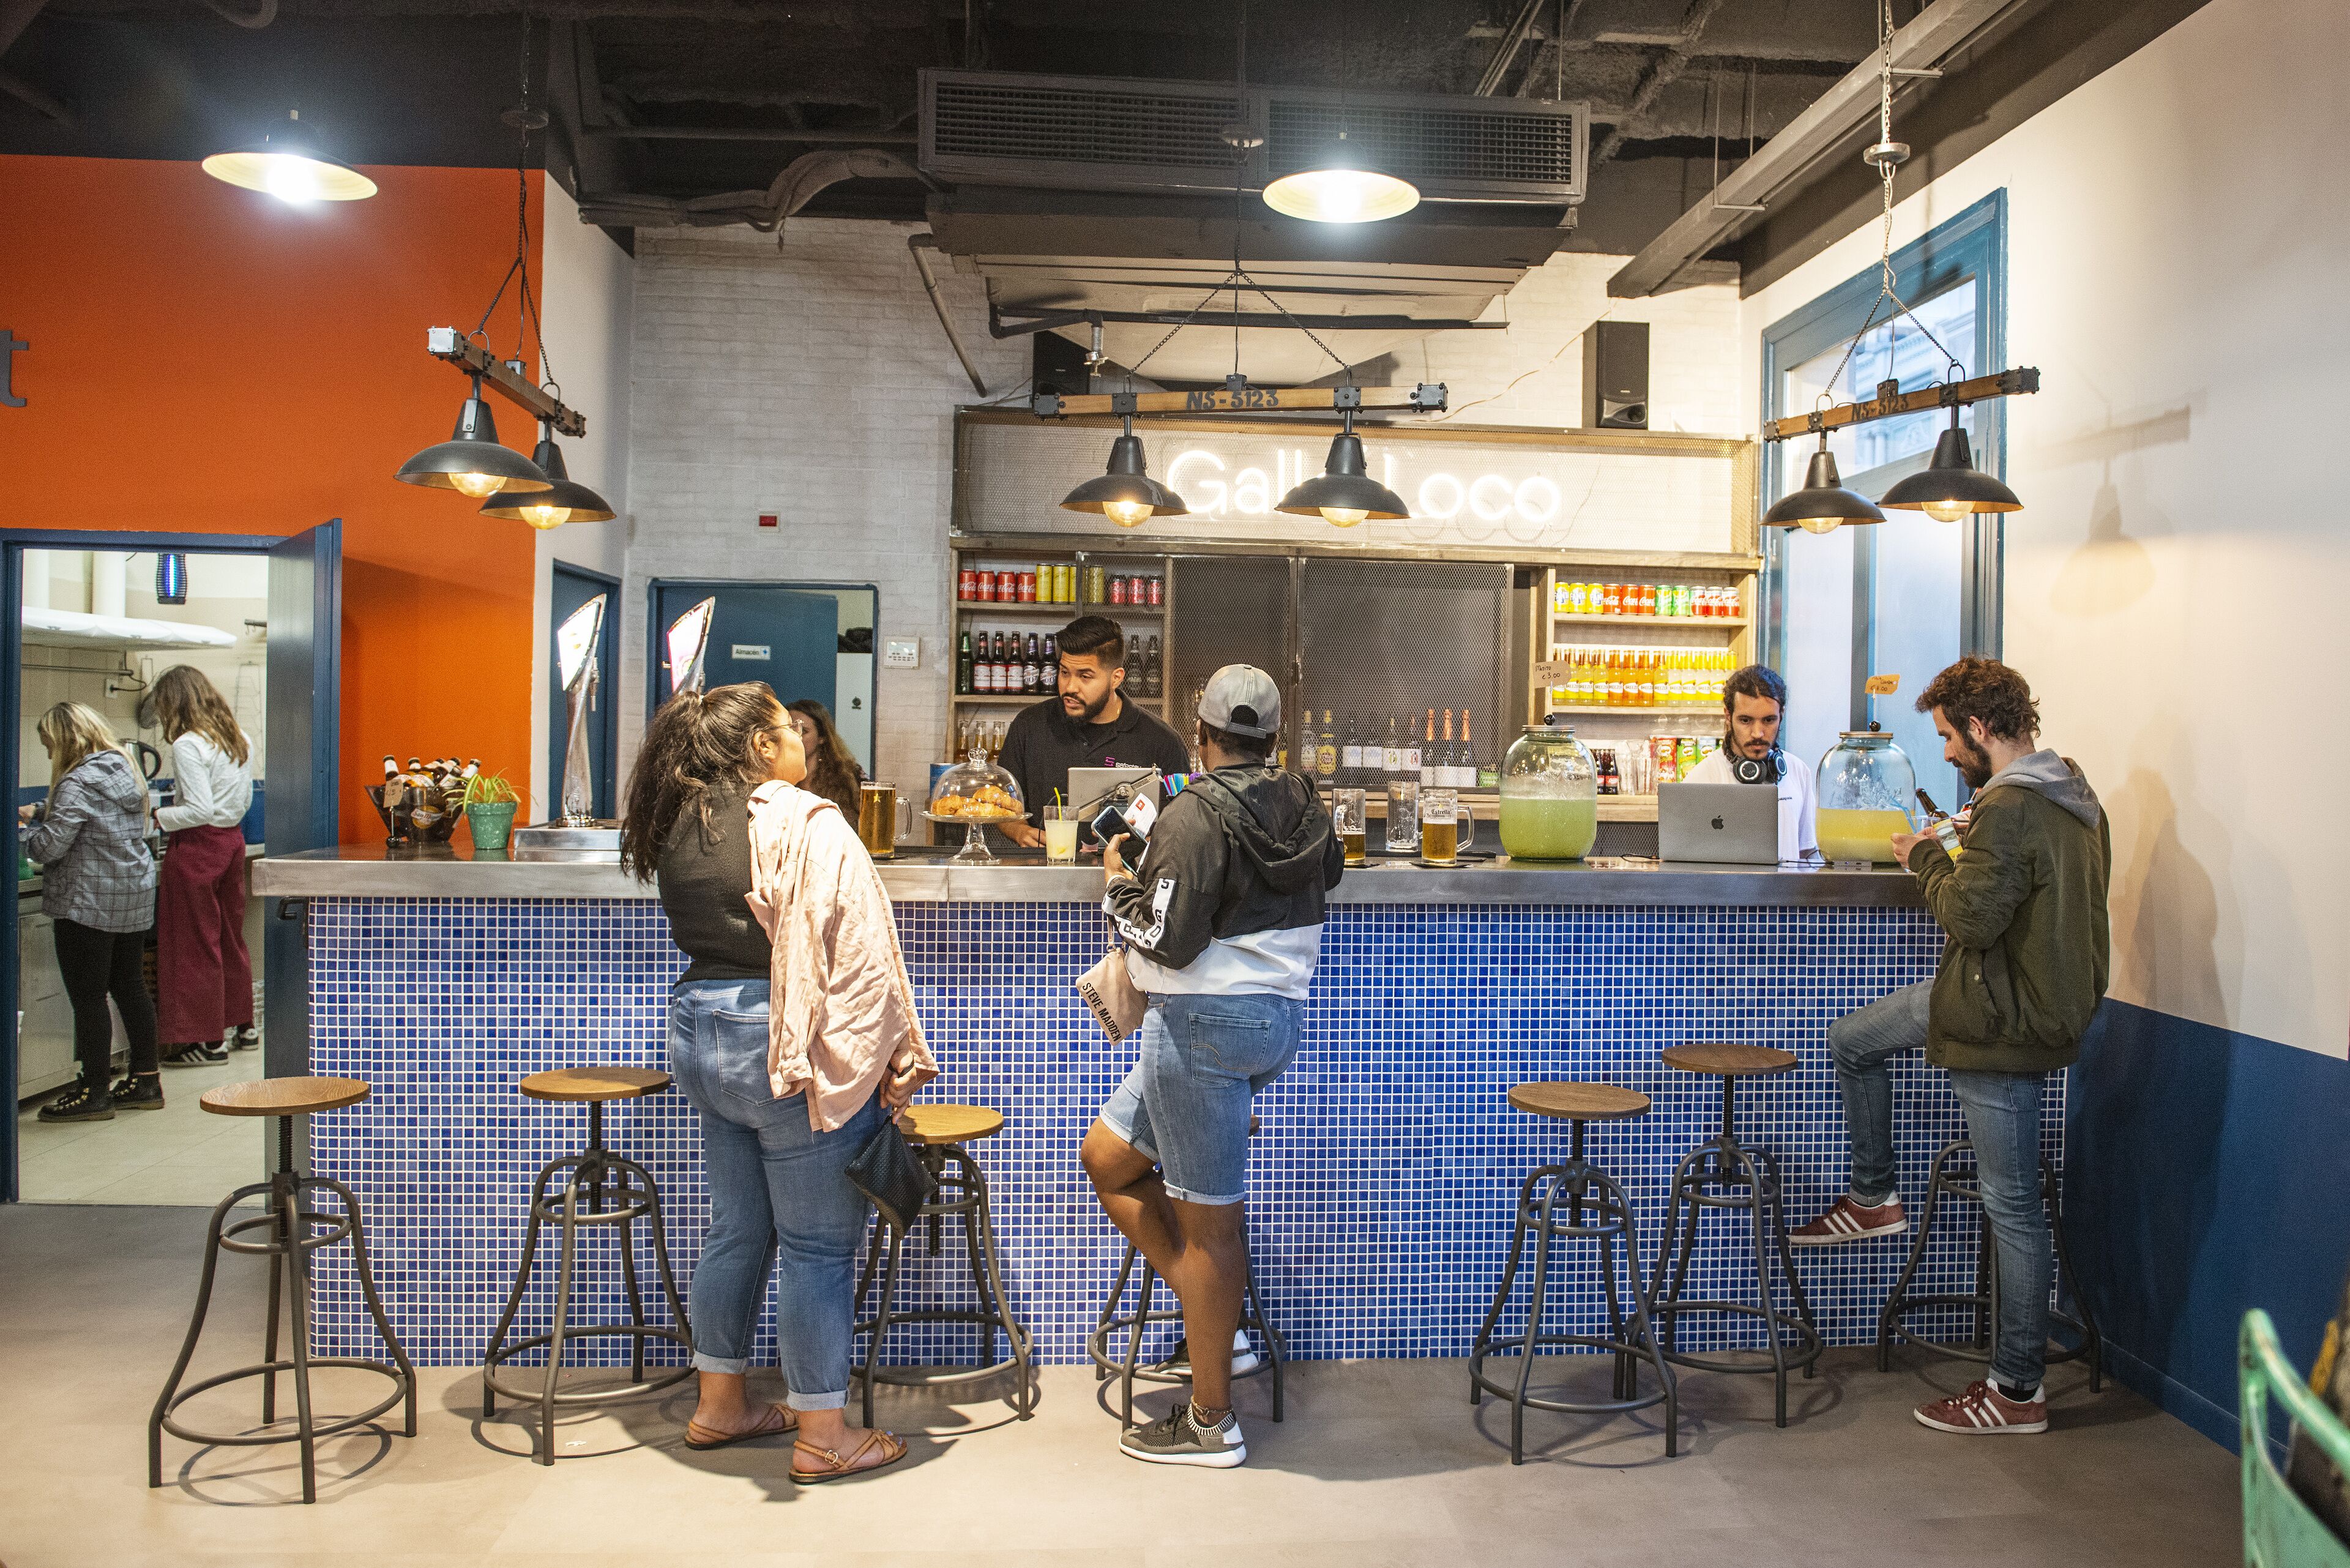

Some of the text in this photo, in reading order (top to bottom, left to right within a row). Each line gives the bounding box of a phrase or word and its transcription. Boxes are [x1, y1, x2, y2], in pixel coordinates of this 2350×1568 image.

[1166, 449, 1327, 515] Gall
[1083, 982, 1122, 1042] STEVE MADDEN
